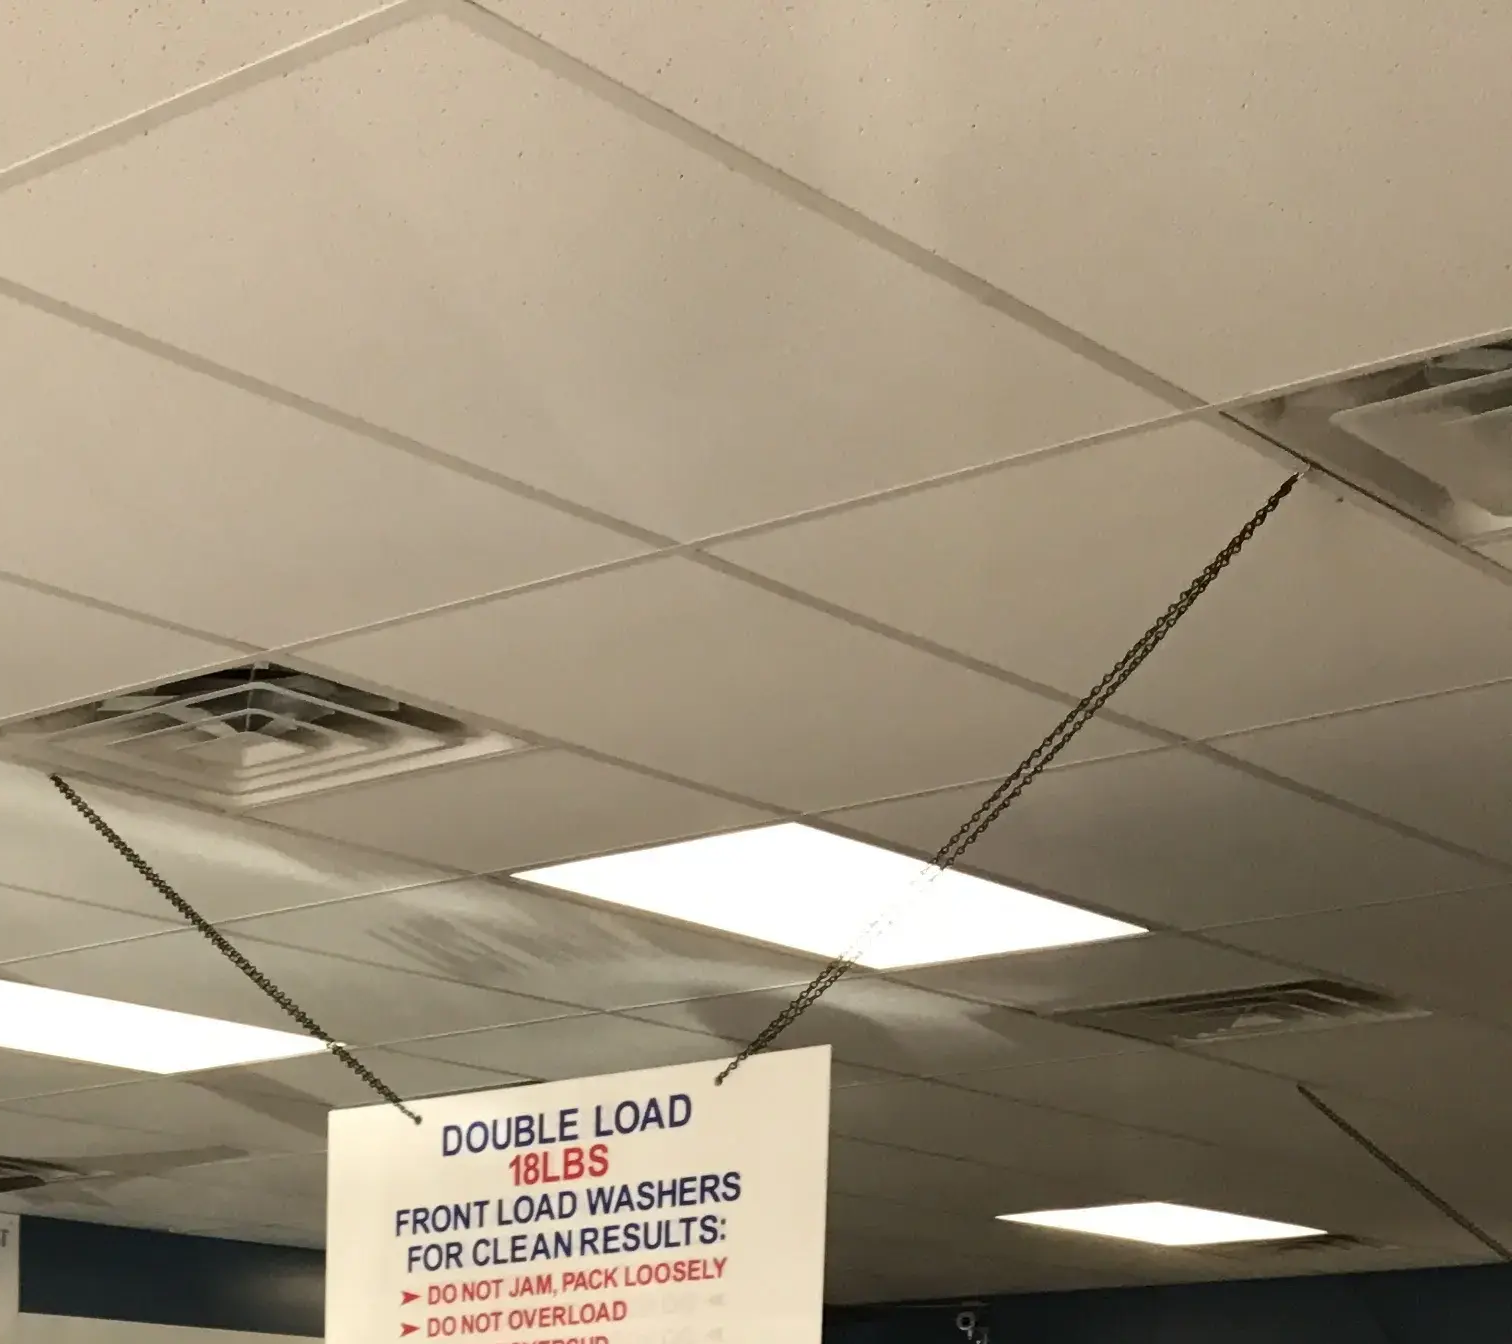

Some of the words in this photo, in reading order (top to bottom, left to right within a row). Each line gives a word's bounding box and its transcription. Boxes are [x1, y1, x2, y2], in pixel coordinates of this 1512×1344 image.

[442, 1107, 579, 1157] DOUBLE
[595, 1094, 691, 1137] LOAD
[509, 1144, 608, 1186] 18LBS
[396, 1200, 490, 1236] FRONT
[498, 1191, 577, 1226] LOAD
[587, 1170, 742, 1216] WASHERS
[408, 1242, 463, 1273] FOR
[473, 1230, 572, 1266] CLEAN
[580, 1215, 727, 1257] RESULTS:
[428, 1284, 457, 1305] DO
[462, 1279, 504, 1302] NOT
[509, 1274, 557, 1297] JAM,
[562, 1267, 618, 1292] PACK
[625, 1257, 727, 1286] LOOSELY
[428, 1316, 456, 1337] DO
[461, 1311, 503, 1334] NOT
[508, 1301, 627, 1330] OVERLOAD
